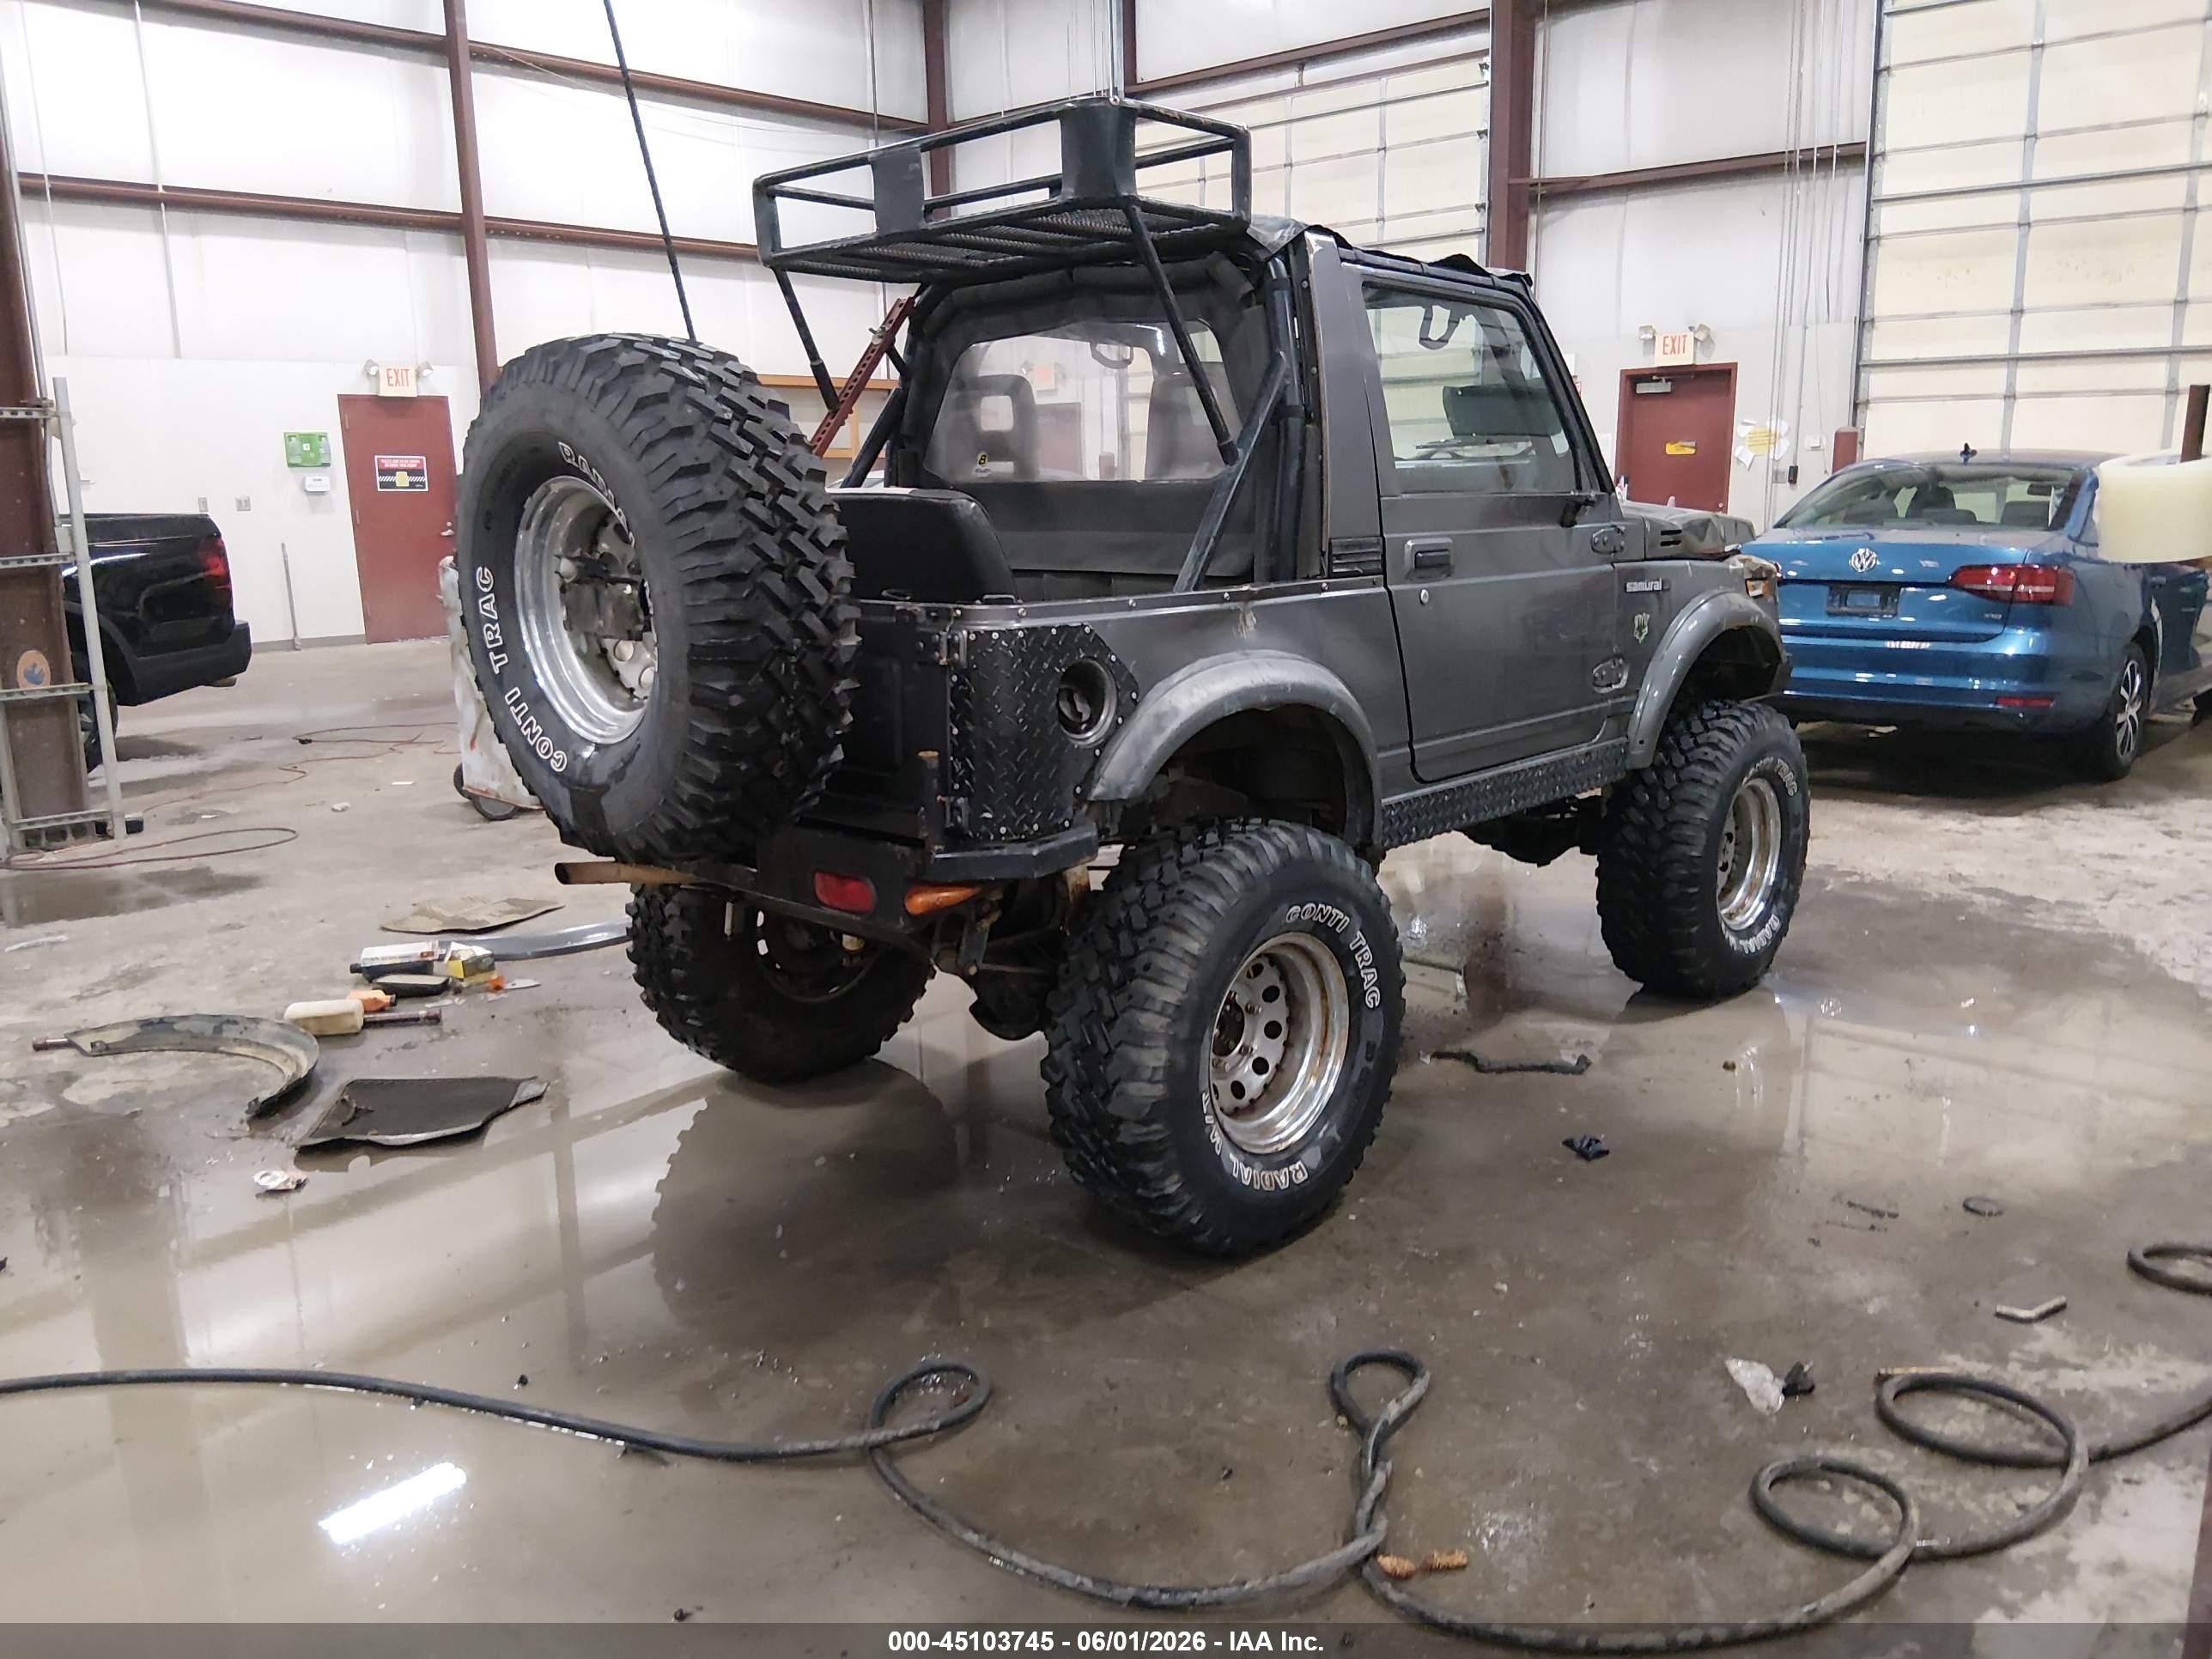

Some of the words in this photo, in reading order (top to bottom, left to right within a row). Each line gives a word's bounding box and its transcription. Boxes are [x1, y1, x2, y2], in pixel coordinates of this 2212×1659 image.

[1662, 333, 1688, 356] EXIT
[386, 368, 410, 387] EXIT
[504, 686, 568, 774] CONTI
[1286, 902, 1352, 934] CONTI
[1229, 1152, 1309, 1191] RADIAL
